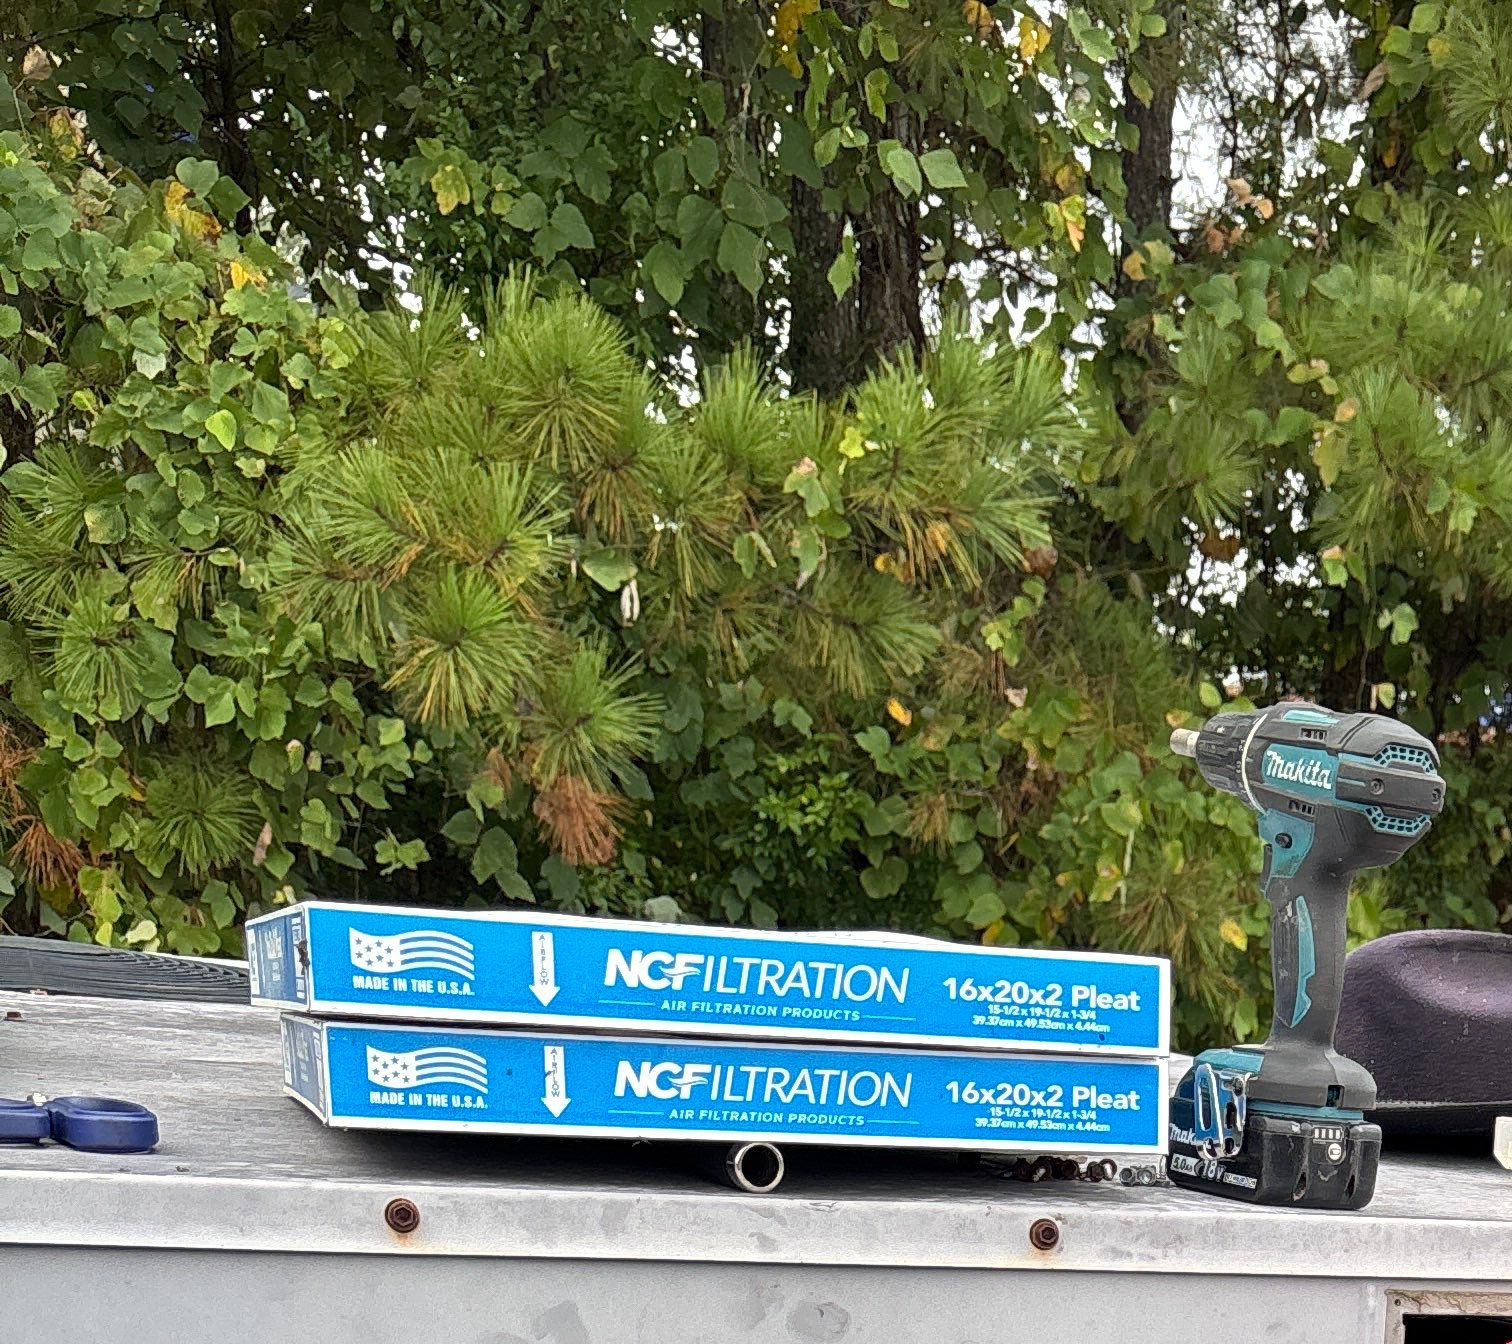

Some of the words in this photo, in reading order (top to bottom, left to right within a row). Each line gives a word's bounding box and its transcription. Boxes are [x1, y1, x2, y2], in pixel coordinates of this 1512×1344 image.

[1266, 750, 1333, 790] Makita
[538, 934, 550, 986] AIRFLOW
[352, 975, 390, 991] MADE
[393, 977, 408, 992] IN
[411, 978, 434, 994] THE
[437, 980, 476, 996] U.S.A.
[603, 948, 910, 1004] NCFILTRATION
[942, 977, 1063, 1007] 16x20x2
[1071, 984, 1141, 1012] Pleat
[660, 1000, 687, 1011] AIR
[691, 1002, 778, 1017] FILTRATION
[781, 1007, 861, 1021] PRODUCTS
[987, 1004, 1020, 1016] 15-1/2
[1071, 1010, 1097, 1020] 1-3/4
[613, 1060, 913, 1108] NCFILTRATION
[945, 1081, 1064, 1107] 16x20x2
[1072, 1085, 1140, 1111] Pleat
[369, 1091, 406, 1106] MADE
[409, 1093, 423, 1106] IN
[426, 1093, 449, 1108] THE
[451, 1094, 489, 1109] U.S.A.
[668, 1109, 695, 1120] AIR
[698, 1110, 784, 1123] FILTRATION
[787, 1113, 865, 1126] PRODUCTS
[989, 1107, 1022, 1117] 15-1/2
[1072, 1110, 1097, 1120] 1-3/4
